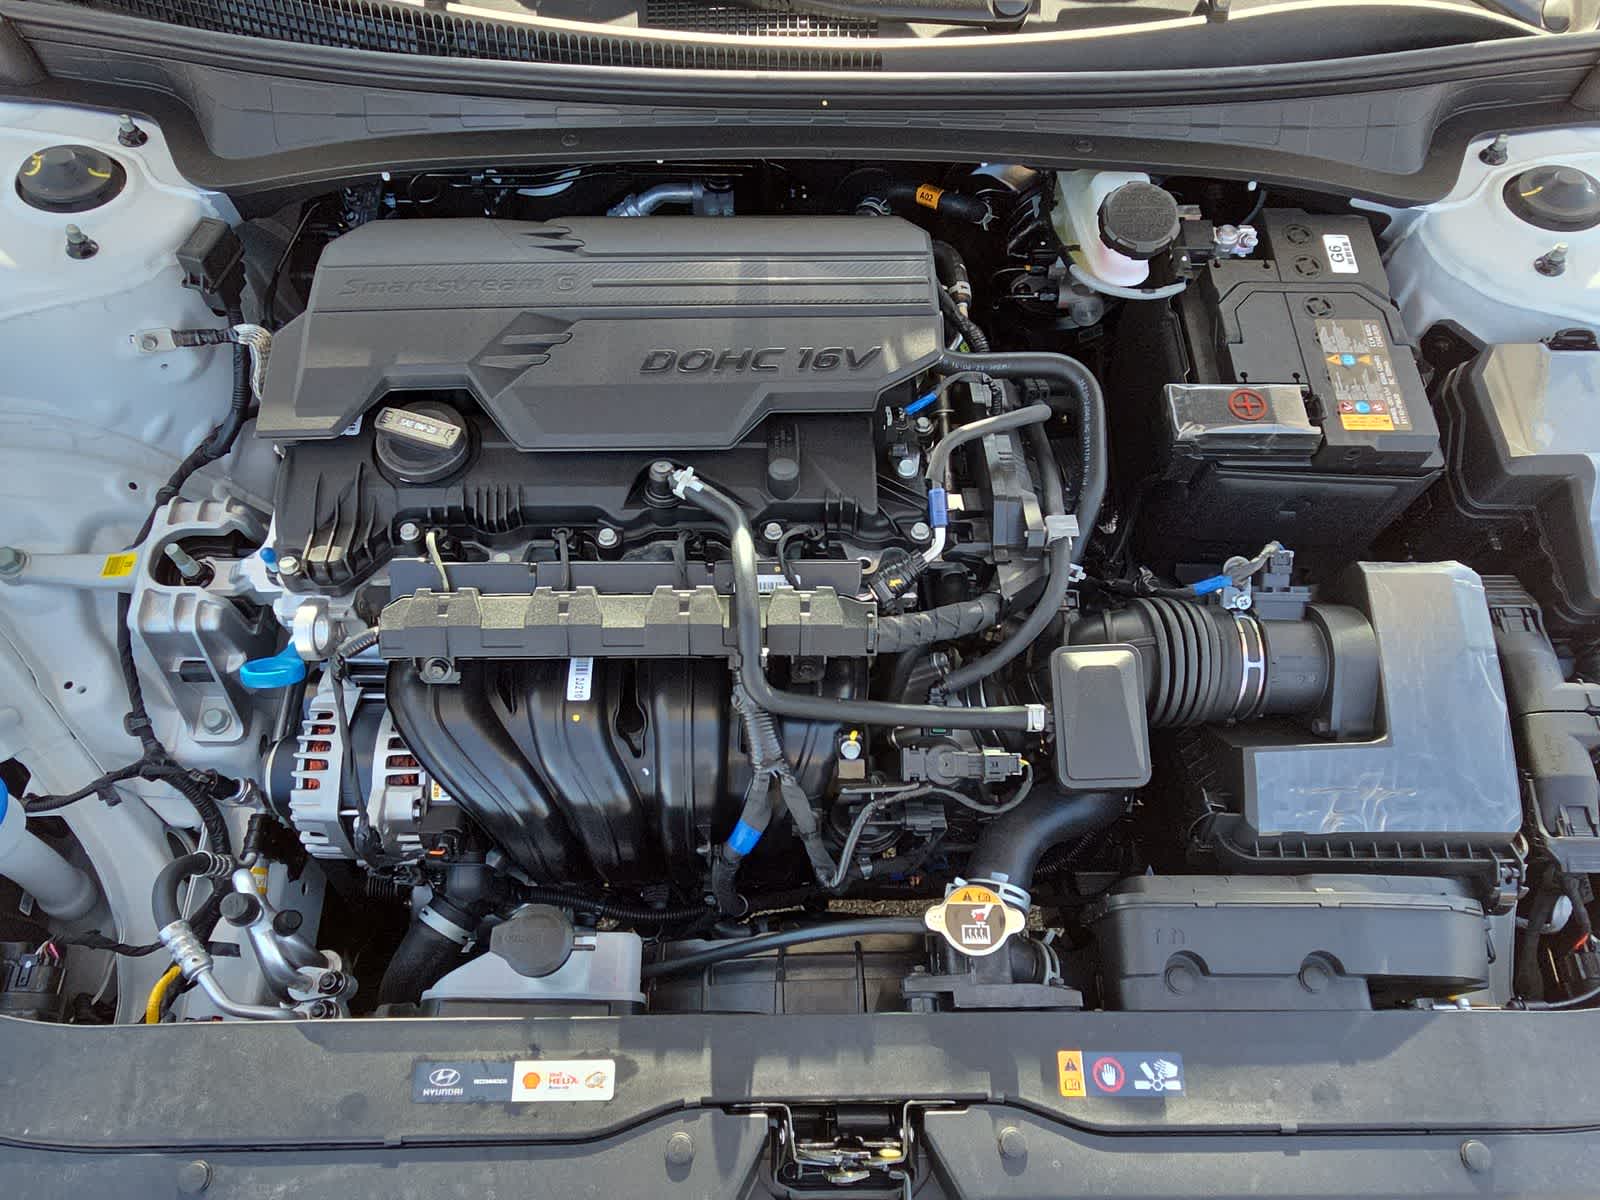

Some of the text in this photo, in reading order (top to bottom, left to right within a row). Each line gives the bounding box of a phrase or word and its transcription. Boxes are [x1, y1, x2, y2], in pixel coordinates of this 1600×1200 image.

[919, 191, 934, 202] A02
[1328, 245, 1345, 263] G6
[639, 345, 883, 373] DOHC 16V
[423, 1087, 464, 1097] HYUNDAI
